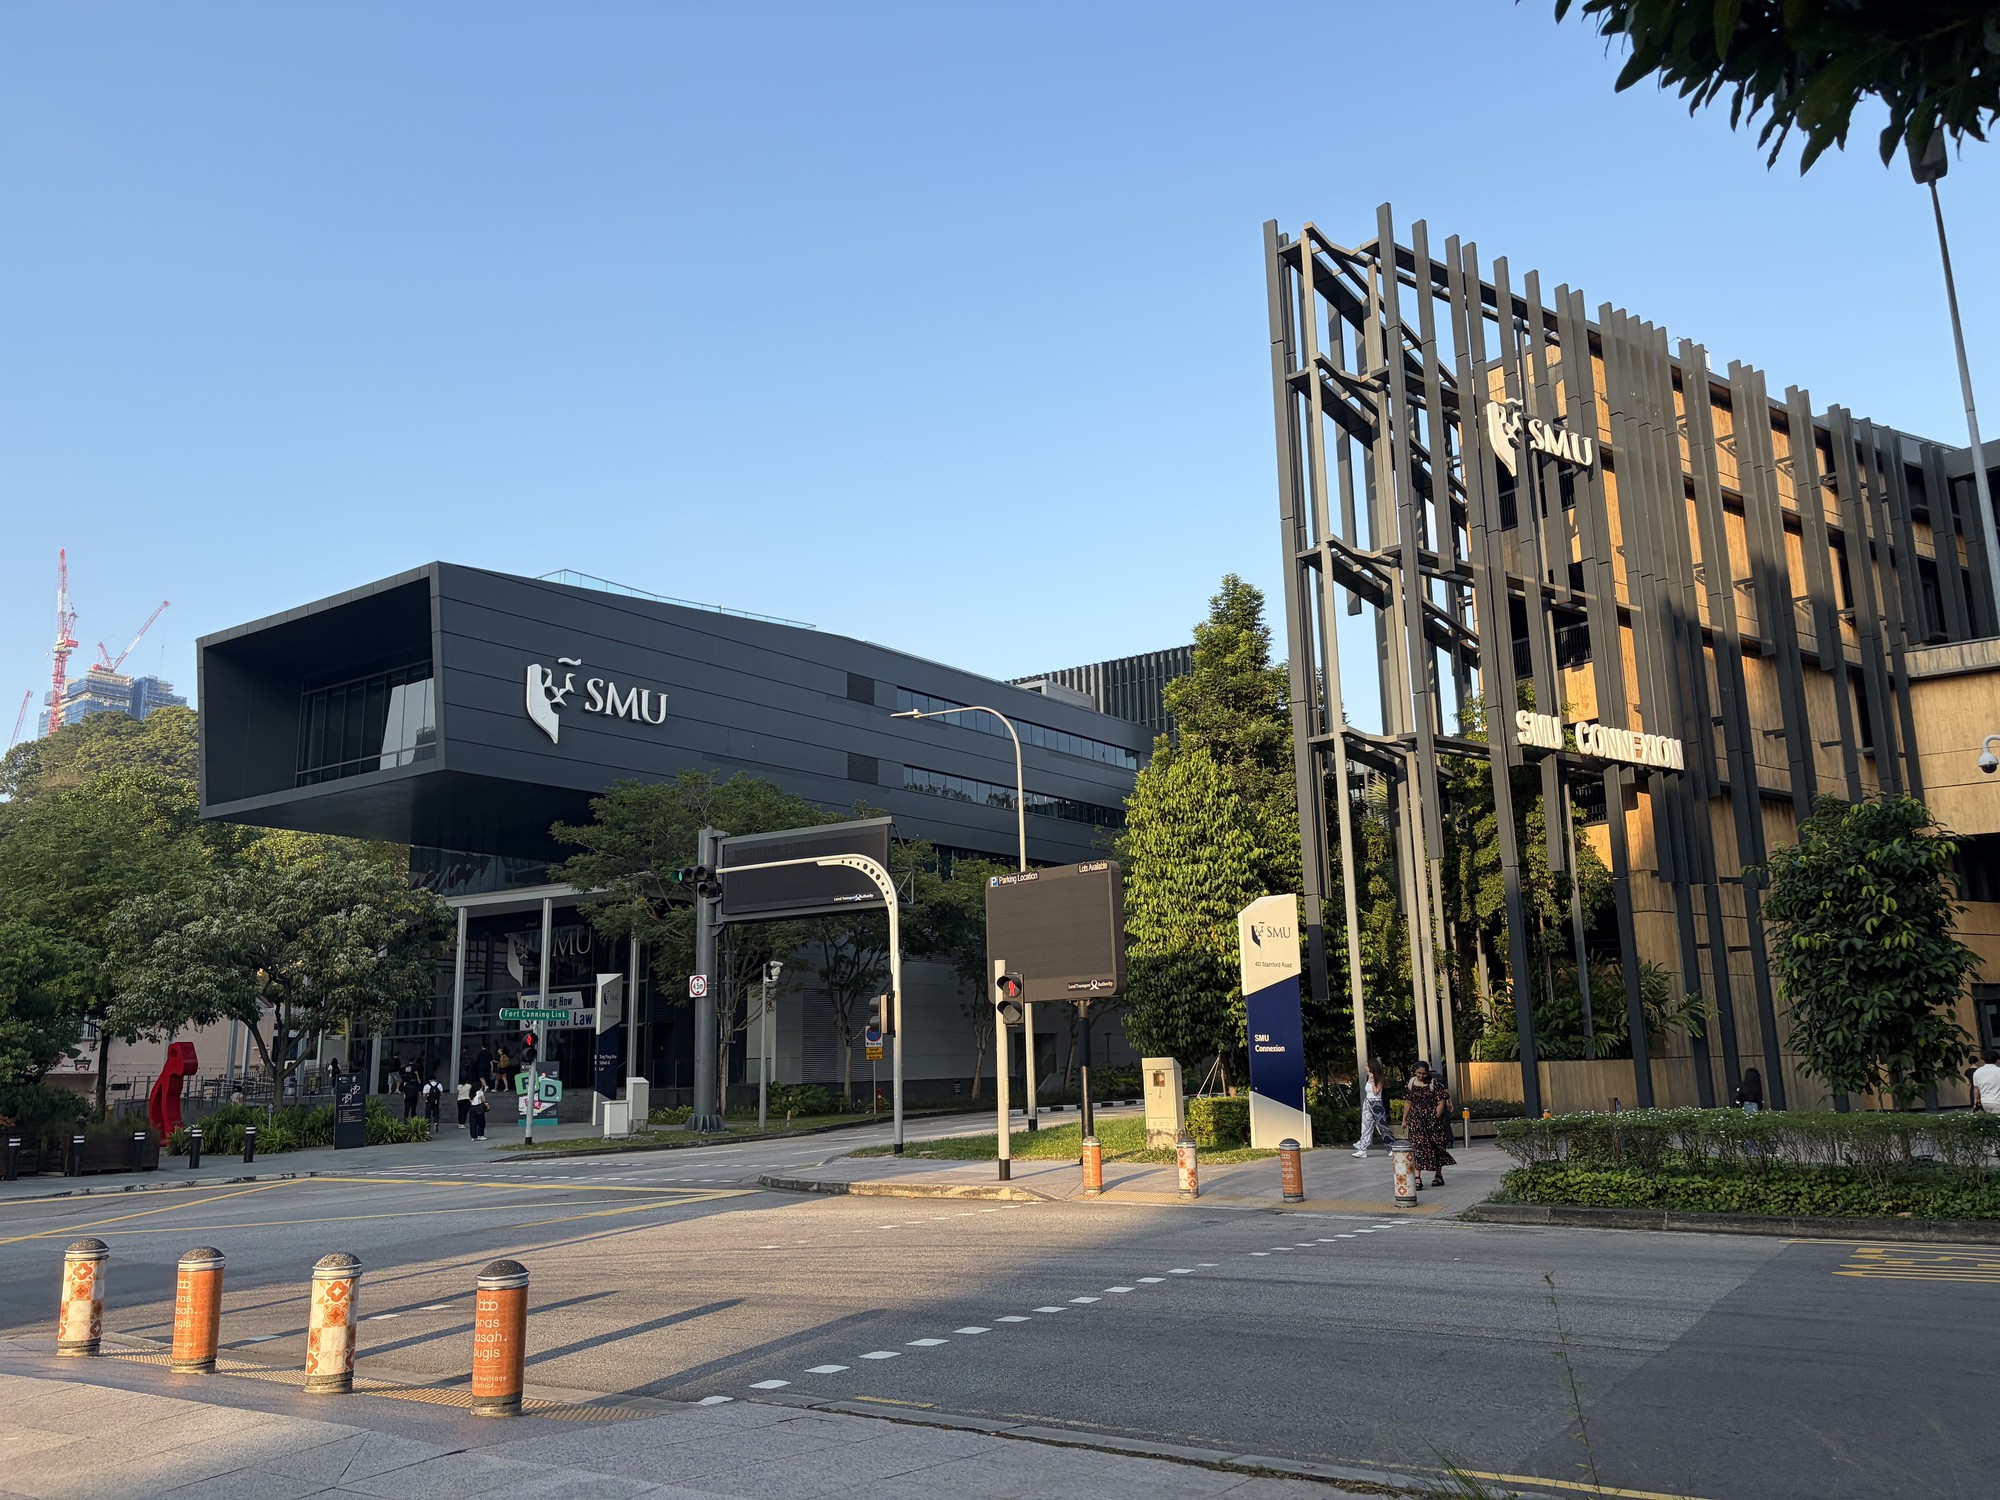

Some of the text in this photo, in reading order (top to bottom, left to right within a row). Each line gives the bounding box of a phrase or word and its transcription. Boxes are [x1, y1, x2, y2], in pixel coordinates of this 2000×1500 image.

[1528, 418, 1593, 467] SMU
[585, 677, 669, 724] SMU
[1515, 709, 1685, 771] SMU CONNEXION
[999, 876, 1017, 885] Parking
[1017, 872, 1038, 882] Location
[1267, 926, 1291, 938] SMU
[552, 926, 592, 957] MU
[522, 999, 539, 1009] Yong
[559, 996, 573, 1006] How
[504, 1010, 566, 1019] Fort Canning Link
[573, 1012, 593, 1026] Law
[1254, 1034, 1270, 1042] SMU
[1255, 1044, 1286, 1053] Connexion
[176, 1295, 192, 1303] ras
[176, 1305, 197, 1315] sah.
[175, 1319, 192, 1331] gis
[474, 1331, 507, 1343] asah.
